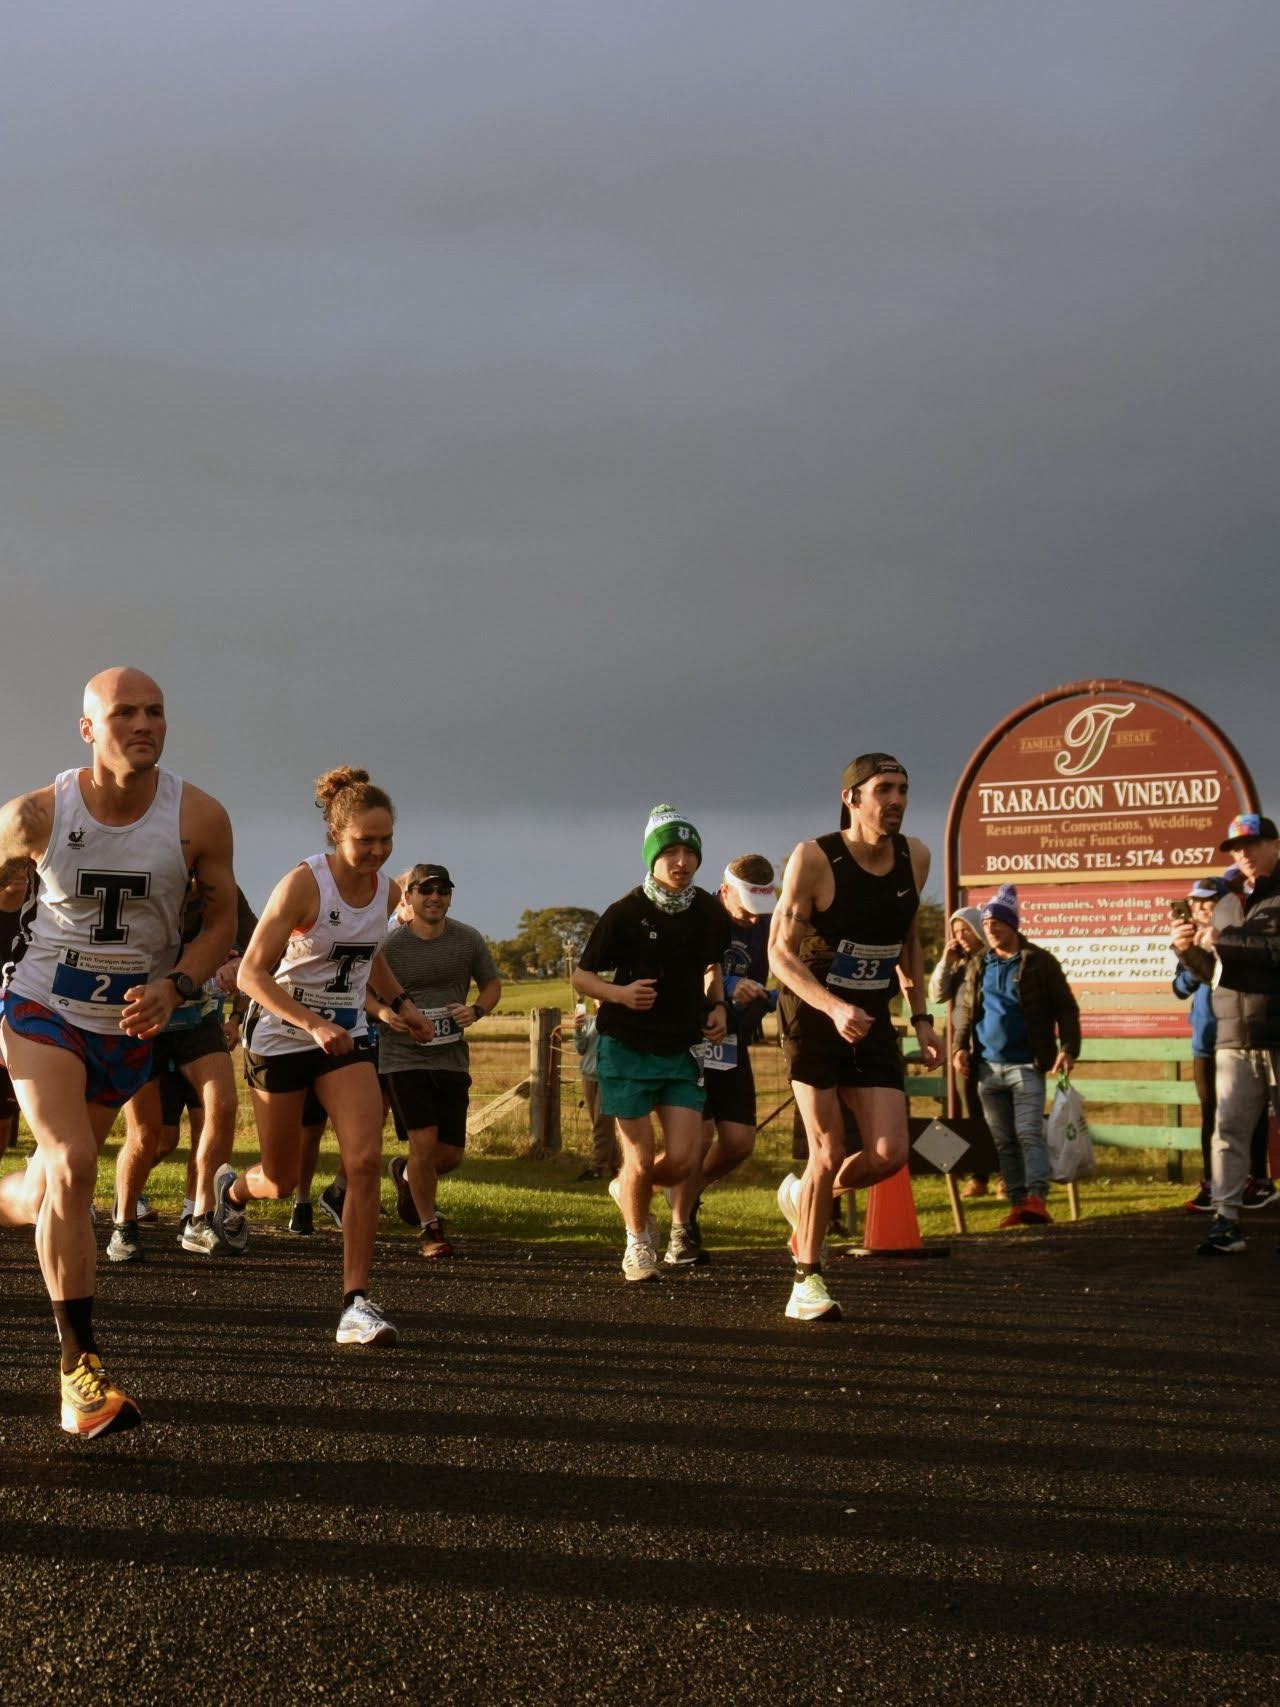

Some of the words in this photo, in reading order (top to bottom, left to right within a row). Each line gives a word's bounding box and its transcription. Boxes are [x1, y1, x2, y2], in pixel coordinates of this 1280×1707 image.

[1020, 738, 1062, 750] ZANELLA
[1116, 732, 1151, 744] ESTATE
[979, 784, 1104, 814] TRARALGON
[1113, 778, 1220, 807] VINEYARD
[986, 822, 1057, 837] Restaurant,
[1061, 818, 1143, 833] Conventions,
[1148, 815, 1213, 831] Weddings
[1040, 836, 1086, 848] Private
[1090, 832, 1154, 846] Functions
[986, 853, 1079, 872] BOOKINGS
[1084, 853, 1121, 868] TEL:
[1126, 849, 1165, 867] 5174
[1171, 847, 1215, 865] 0557
[76, 868, 151, 945] T
[1099, 897, 1151, 909] Wedding
[1033, 912, 1107, 923] Conferences
[1110, 913, 1123, 922] or
[1127, 911, 1164, 923] Large
[1069, 926, 1089, 937] Day
[1093, 927, 1107, 935] or
[1111, 925, 1140, 936] Night
[1144, 925, 1160, 935] of
[1067, 945, 1082, 953] or
[1090, 943, 1140, 955] Group
[324, 941, 378, 993] T
[851, 960, 880, 979] 33
[1062, 956, 1165, 967] Appointment
[1128, 968, 1173, 978] Notic
[90, 974, 111, 1002] 2
[704, 1041, 724, 1061] 50
